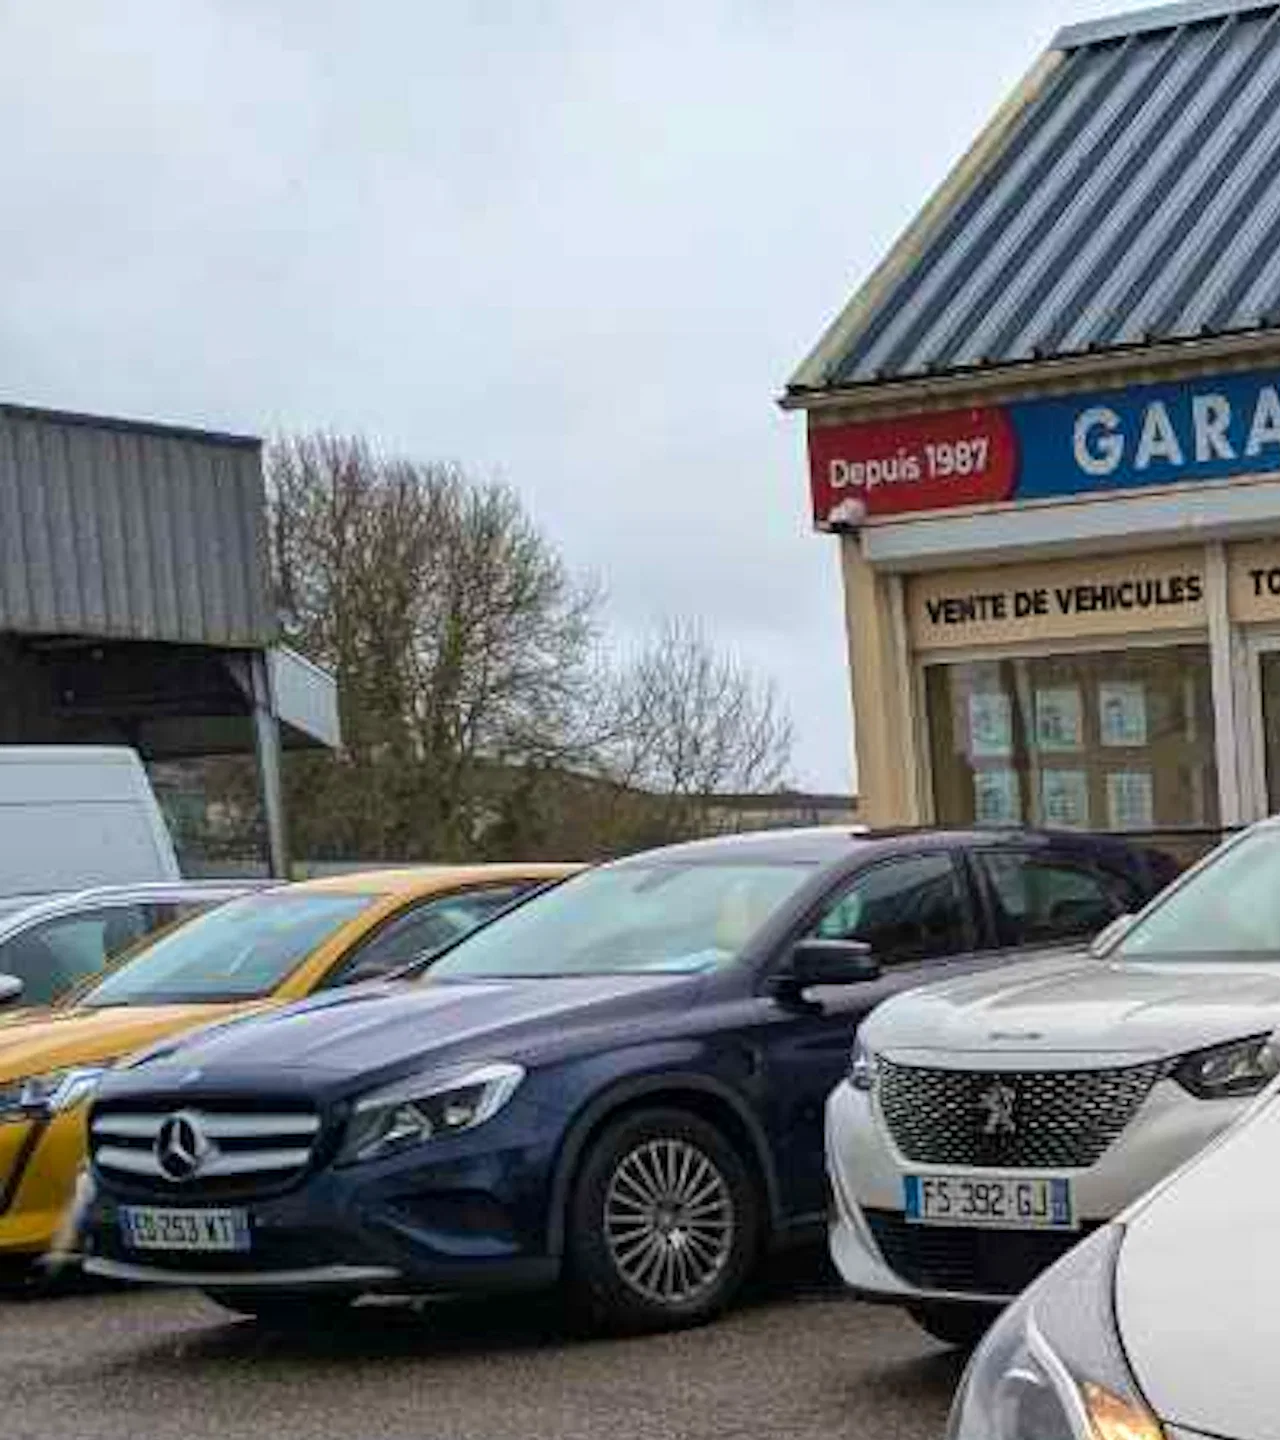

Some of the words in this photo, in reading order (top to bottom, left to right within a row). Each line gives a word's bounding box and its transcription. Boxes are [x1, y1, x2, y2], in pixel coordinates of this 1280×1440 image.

[828, 446, 921, 490] Depuis
[925, 436, 990, 477] 1987
[926, 593, 1008, 625] VENTE
[1014, 588, 1048, 618] DE
[1054, 575, 1202, 614] VEHICULES
[961, 1183, 1006, 1217] 392
[1017, 1183, 1048, 1217] GJ
